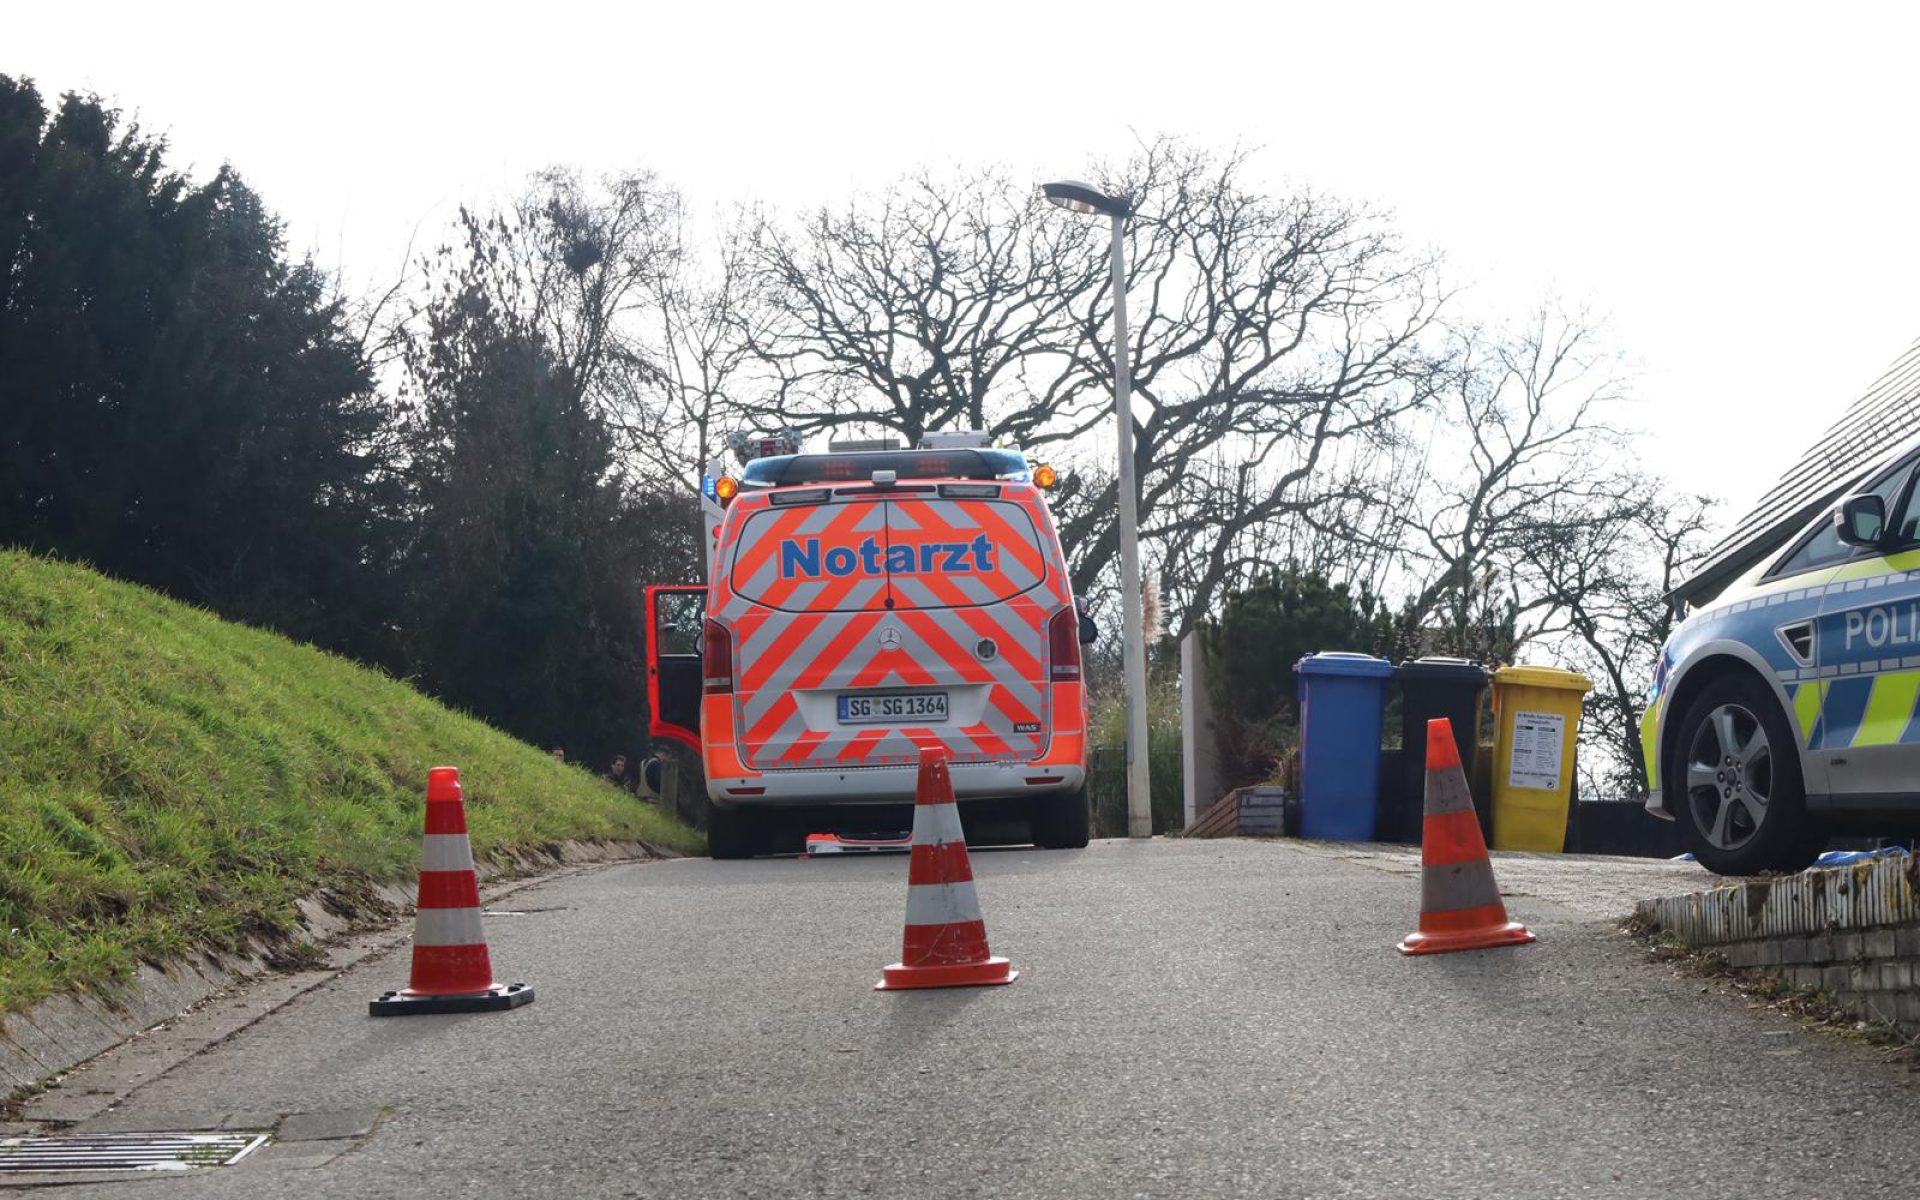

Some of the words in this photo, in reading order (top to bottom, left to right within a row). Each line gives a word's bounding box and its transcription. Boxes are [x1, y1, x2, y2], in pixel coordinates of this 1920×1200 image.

[781, 533, 994, 578] Notarzt
[1845, 603, 1920, 650] POLI
[850, 700, 870, 716] SG
[883, 698, 902, 715] SG
[906, 697, 944, 714] 1364
